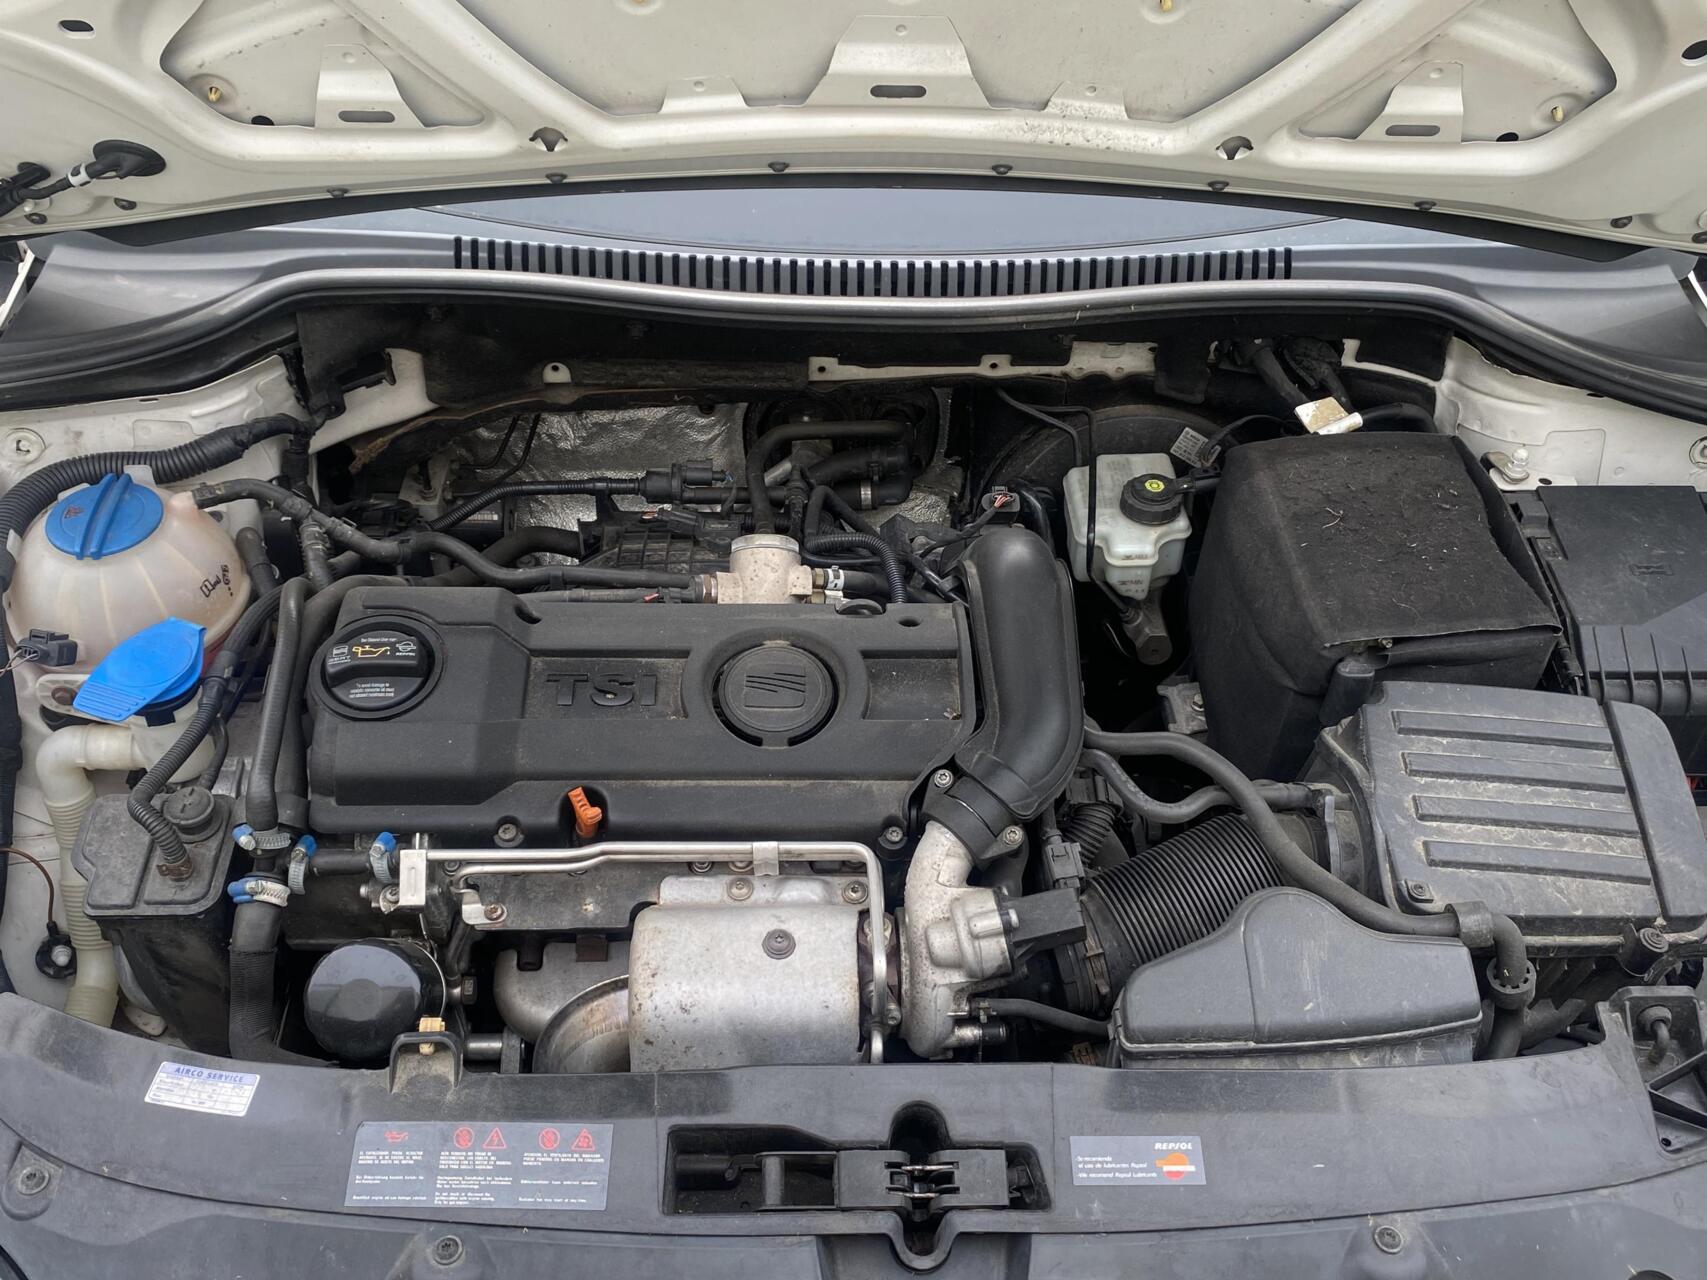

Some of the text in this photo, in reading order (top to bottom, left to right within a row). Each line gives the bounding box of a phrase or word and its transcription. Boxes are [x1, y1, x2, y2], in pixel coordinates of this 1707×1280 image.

[546, 672, 657, 707] TSI
[174, 1067, 244, 1083] AIRCO SERVICE
[1154, 1142, 1192, 1150] REPSOL
